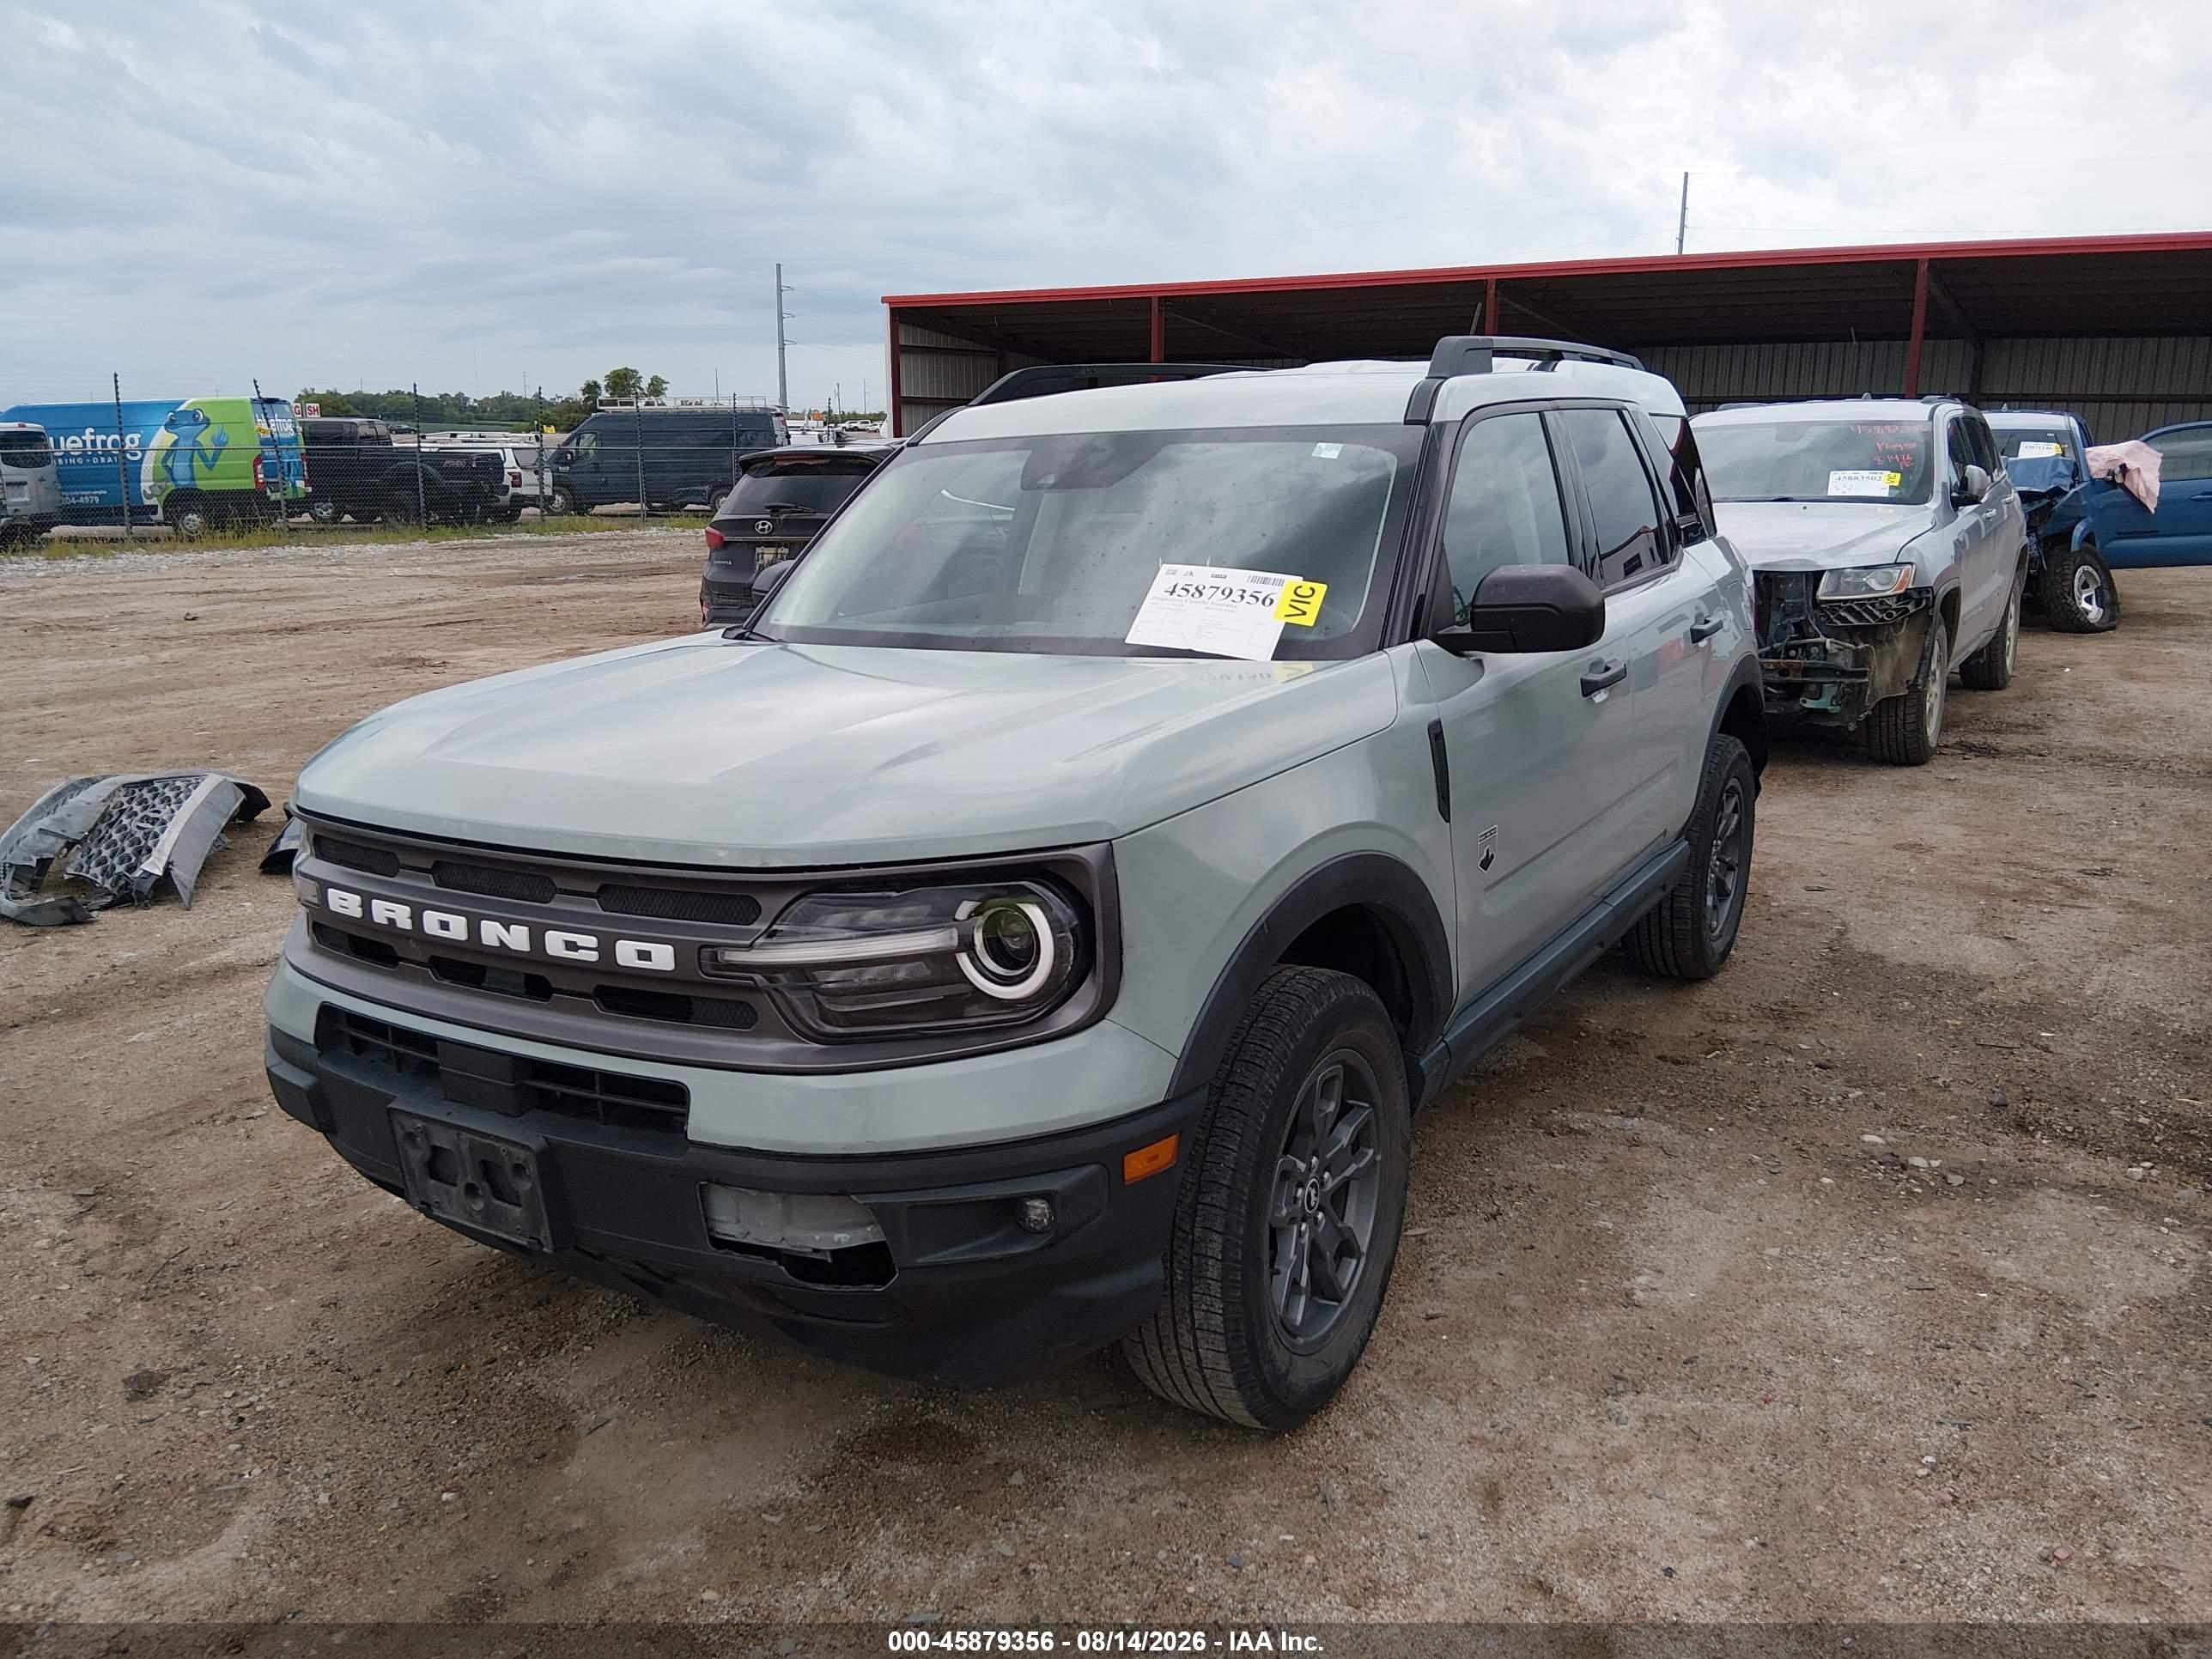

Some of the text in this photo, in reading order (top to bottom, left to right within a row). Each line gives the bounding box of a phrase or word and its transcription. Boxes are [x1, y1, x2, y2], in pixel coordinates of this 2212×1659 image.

[307, 404, 319, 416] SH
[54, 457, 83, 465] BING
[1164, 582, 1275, 608] 45879356
[1284, 584, 1317, 619] VIC
[327, 888, 676, 971] BRONCO
